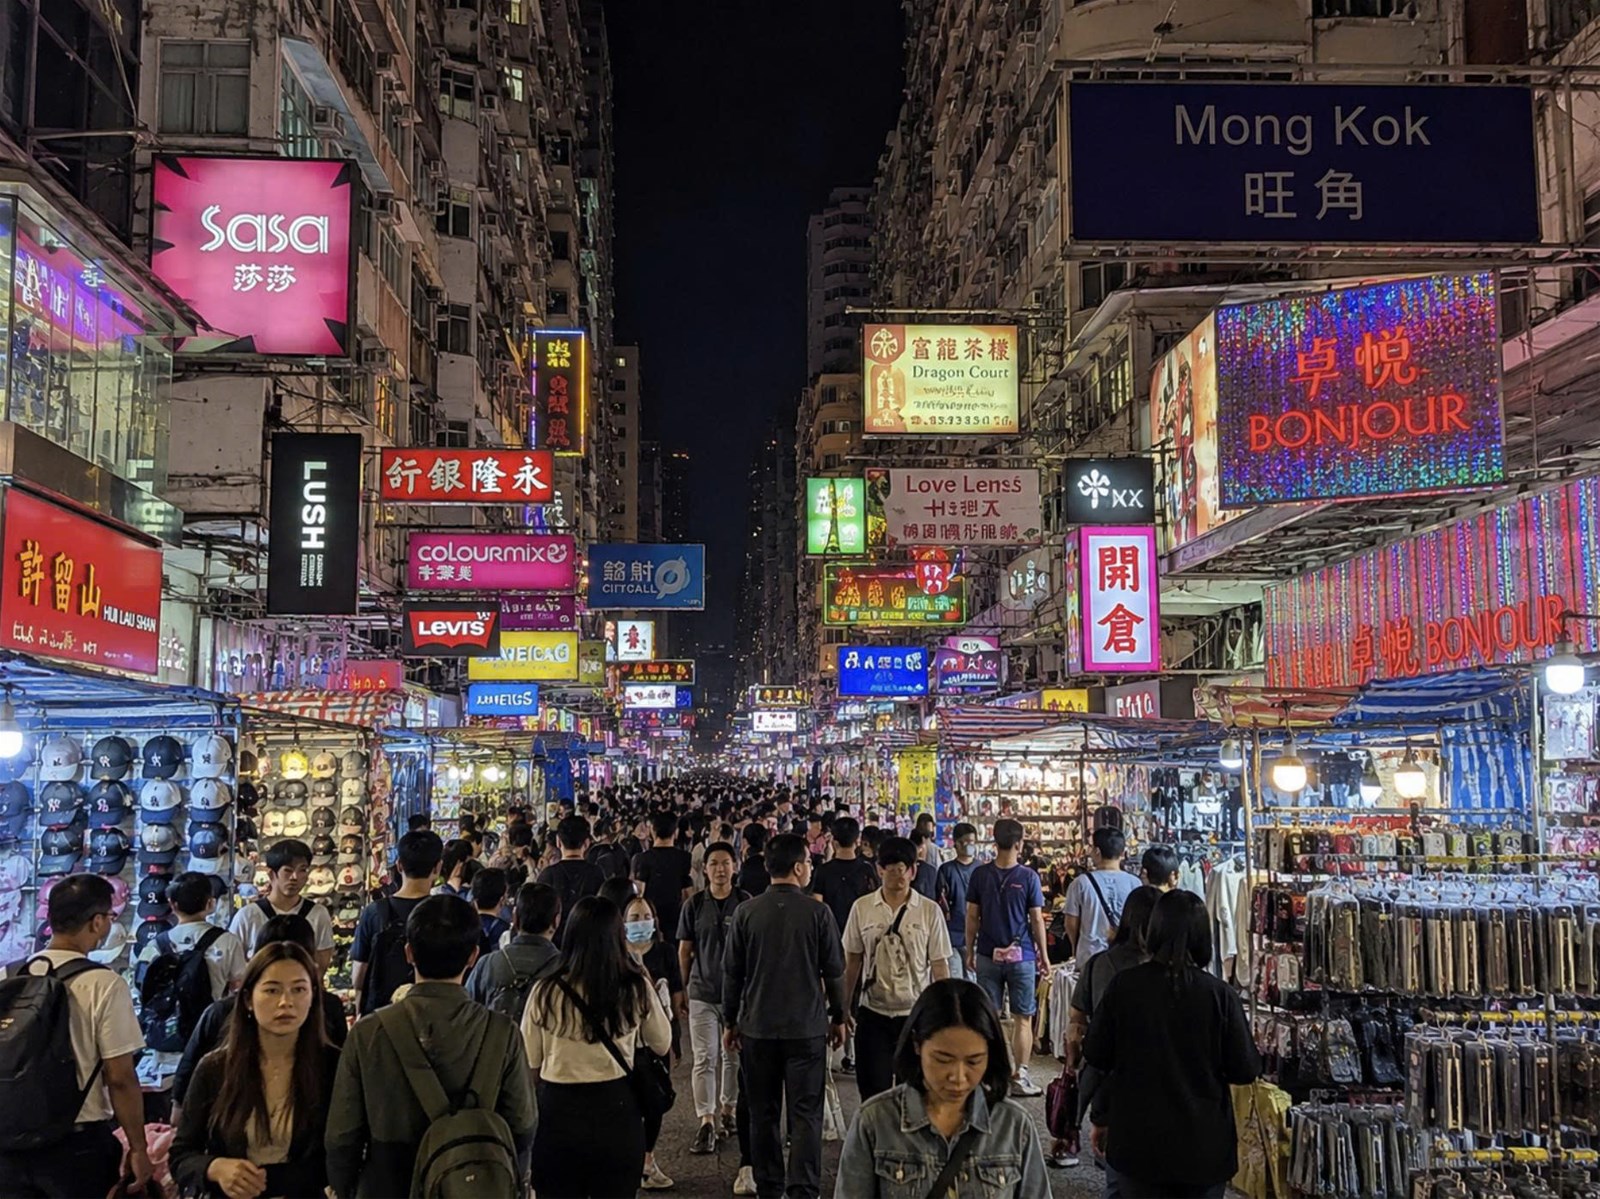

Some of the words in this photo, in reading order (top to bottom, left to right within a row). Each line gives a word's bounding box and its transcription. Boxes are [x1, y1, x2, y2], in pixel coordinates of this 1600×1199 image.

[1175, 104, 1313, 155] Mong
[1334, 105, 1431, 146] Kok
[1244, 168, 1364, 221] 旺角
[232, 263, 296, 293] 莎莎
[912, 365, 965, 381] Dragon
[969, 365, 1009, 379] Court
[1248, 392, 1471, 451] BONJOUR
[301, 461, 327, 549] LUSH
[906, 475, 957, 493] Love
[19, 539, 101, 619] 許留山
[1097, 545, 1145, 654] 開倉
[103, 605, 119, 624] HUI
[119, 609, 136, 628] LAU
[136, 614, 157, 633] SHAN
[1425, 594, 1567, 665] BONJOUR
